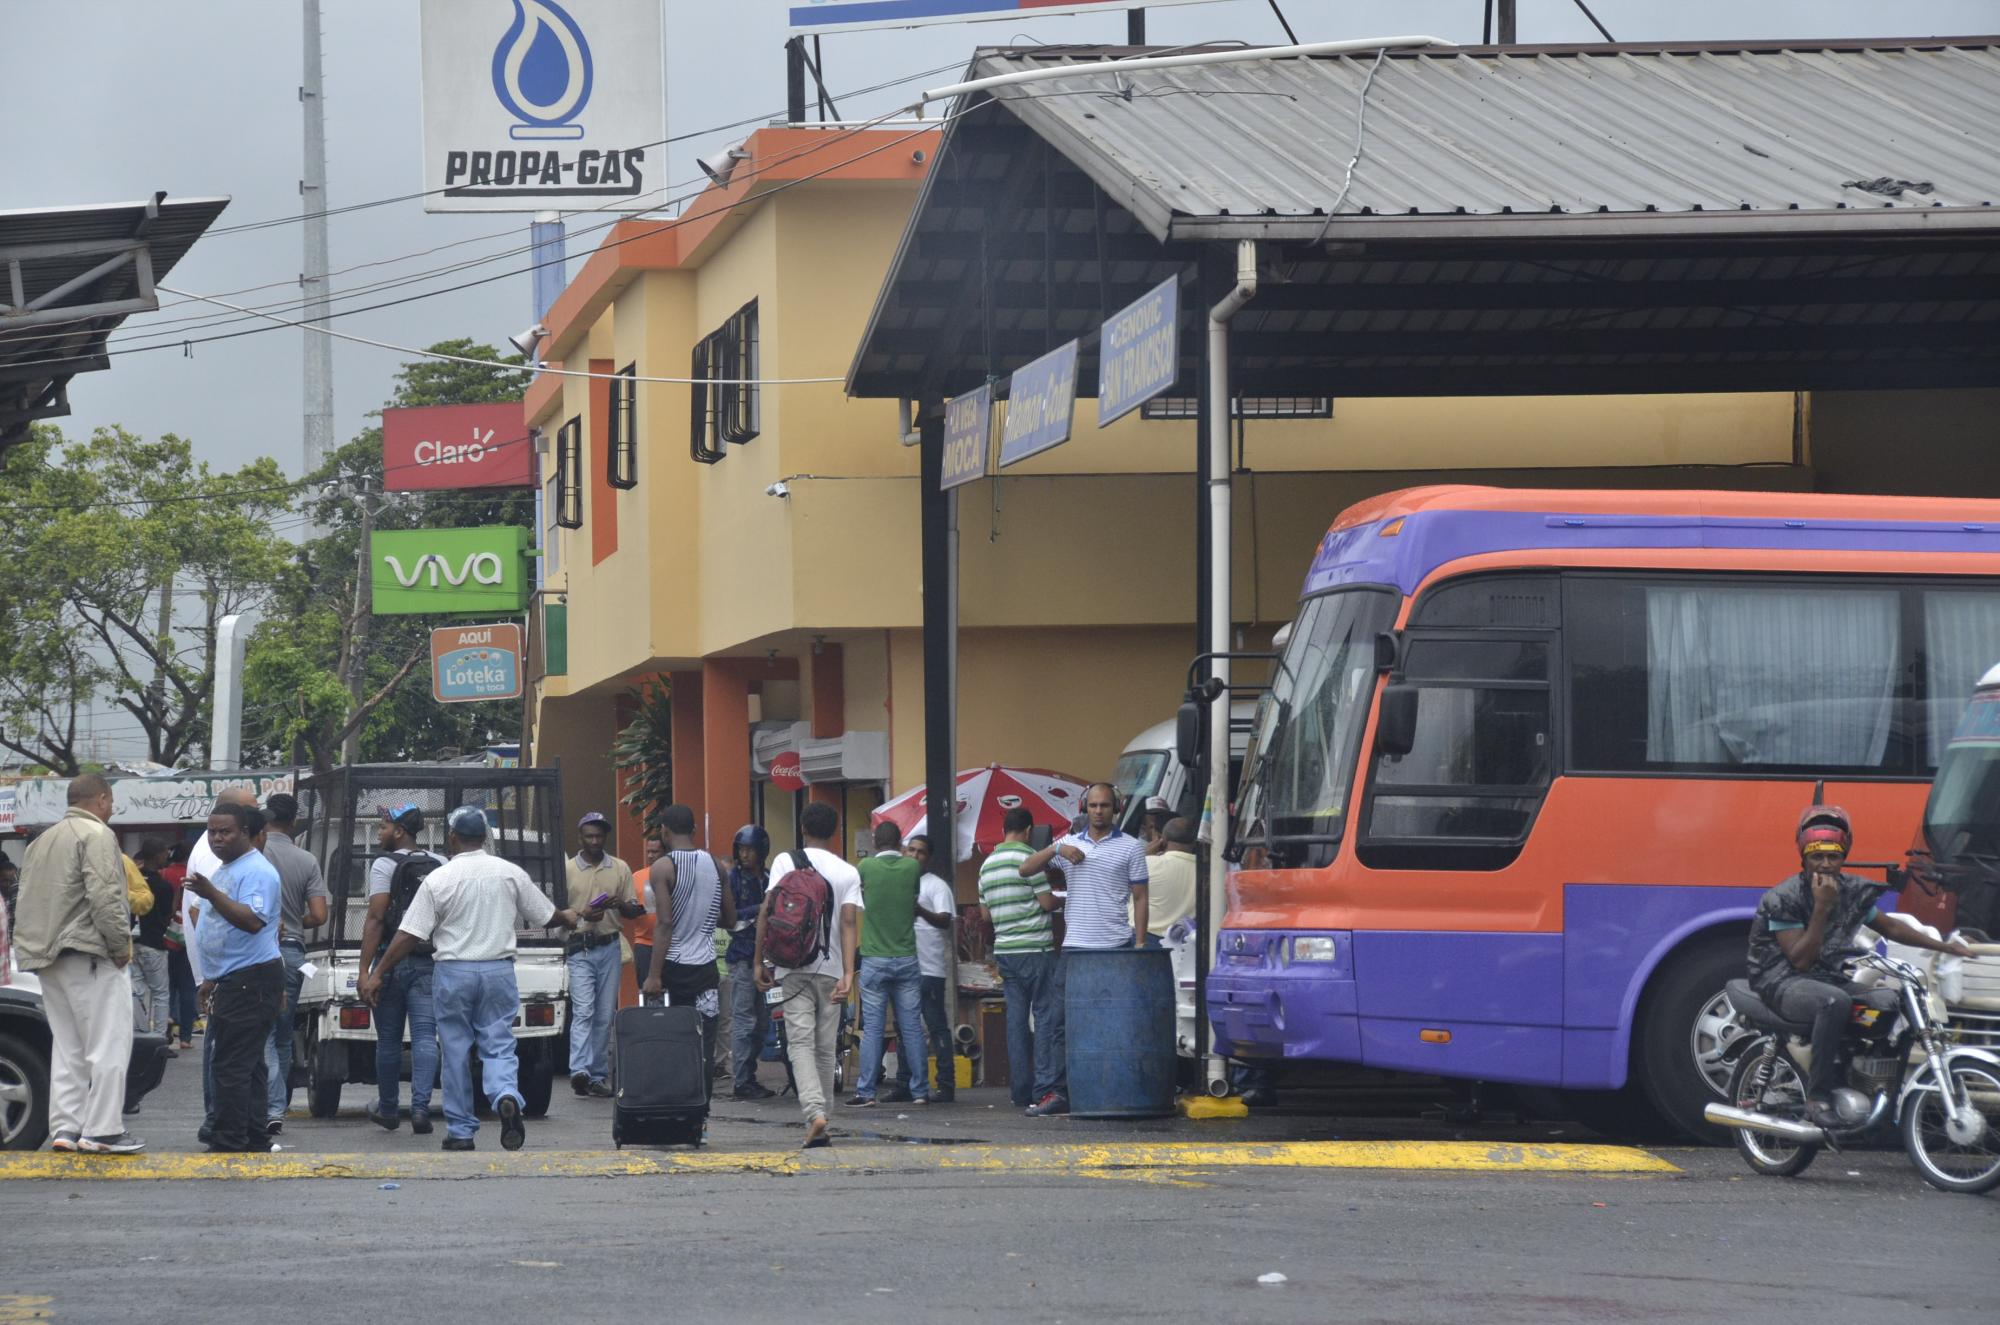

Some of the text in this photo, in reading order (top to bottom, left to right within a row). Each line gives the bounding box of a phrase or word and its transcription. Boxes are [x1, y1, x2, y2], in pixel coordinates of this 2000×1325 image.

[444, 149, 645, 196] PROPA-GAS
[1114, 295, 1163, 349] CENOVIC
[1103, 322, 1175, 412] SAN FRANCISCO
[414, 437, 486, 466] Claro
[944, 432, 980, 481] MOCA
[384, 551, 503, 587] viva
[446, 666, 505, 686] Loteka
